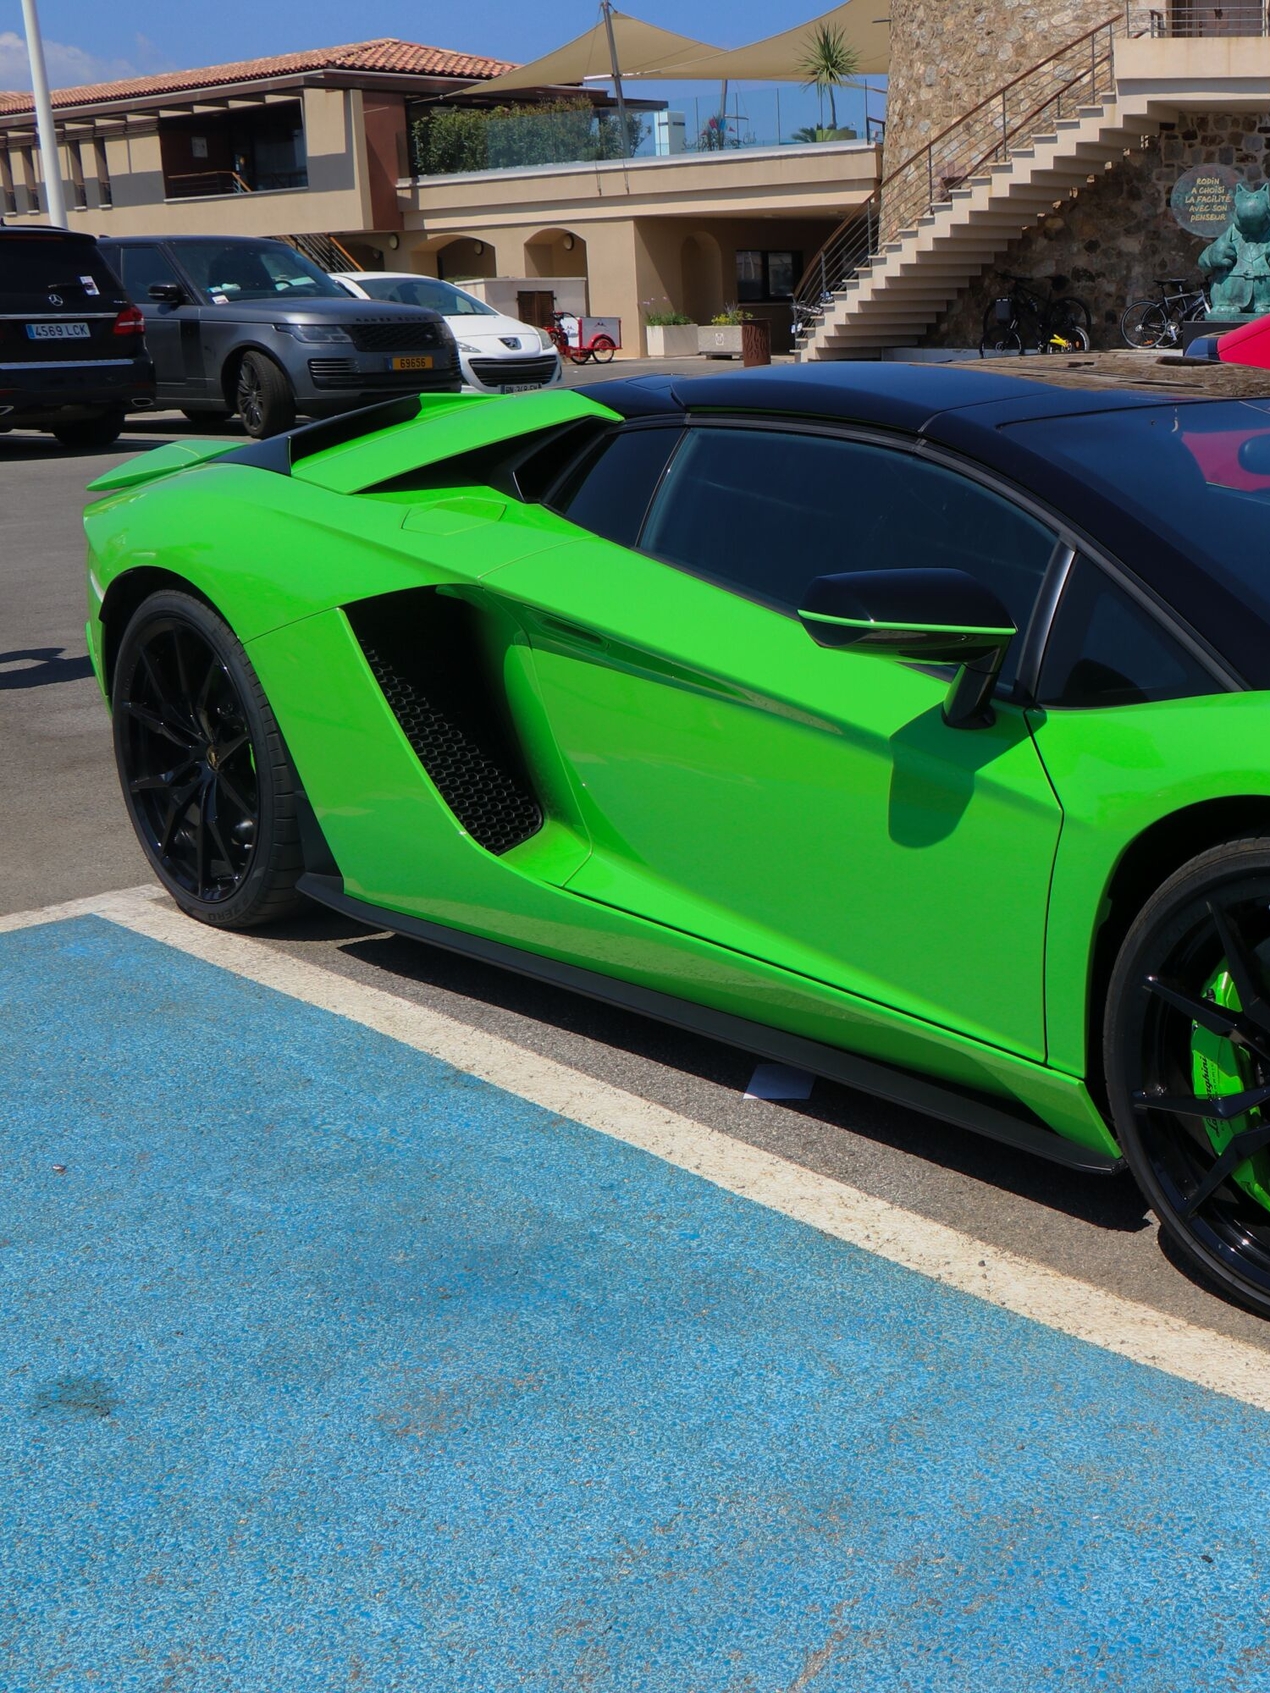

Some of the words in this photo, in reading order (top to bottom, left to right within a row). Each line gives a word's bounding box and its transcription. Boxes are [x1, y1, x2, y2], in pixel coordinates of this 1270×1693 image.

[1196, 177, 1220, 185] RODIN
[1199, 186, 1225, 194] CHOISI
[1189, 204, 1210, 212] AVEC
[1212, 204, 1228, 212] SON
[35, 323, 63, 337] 4569
[65, 324, 88, 336] LCK
[400, 358, 426, 368] 69656
[207, 905, 241, 921] ZERO
